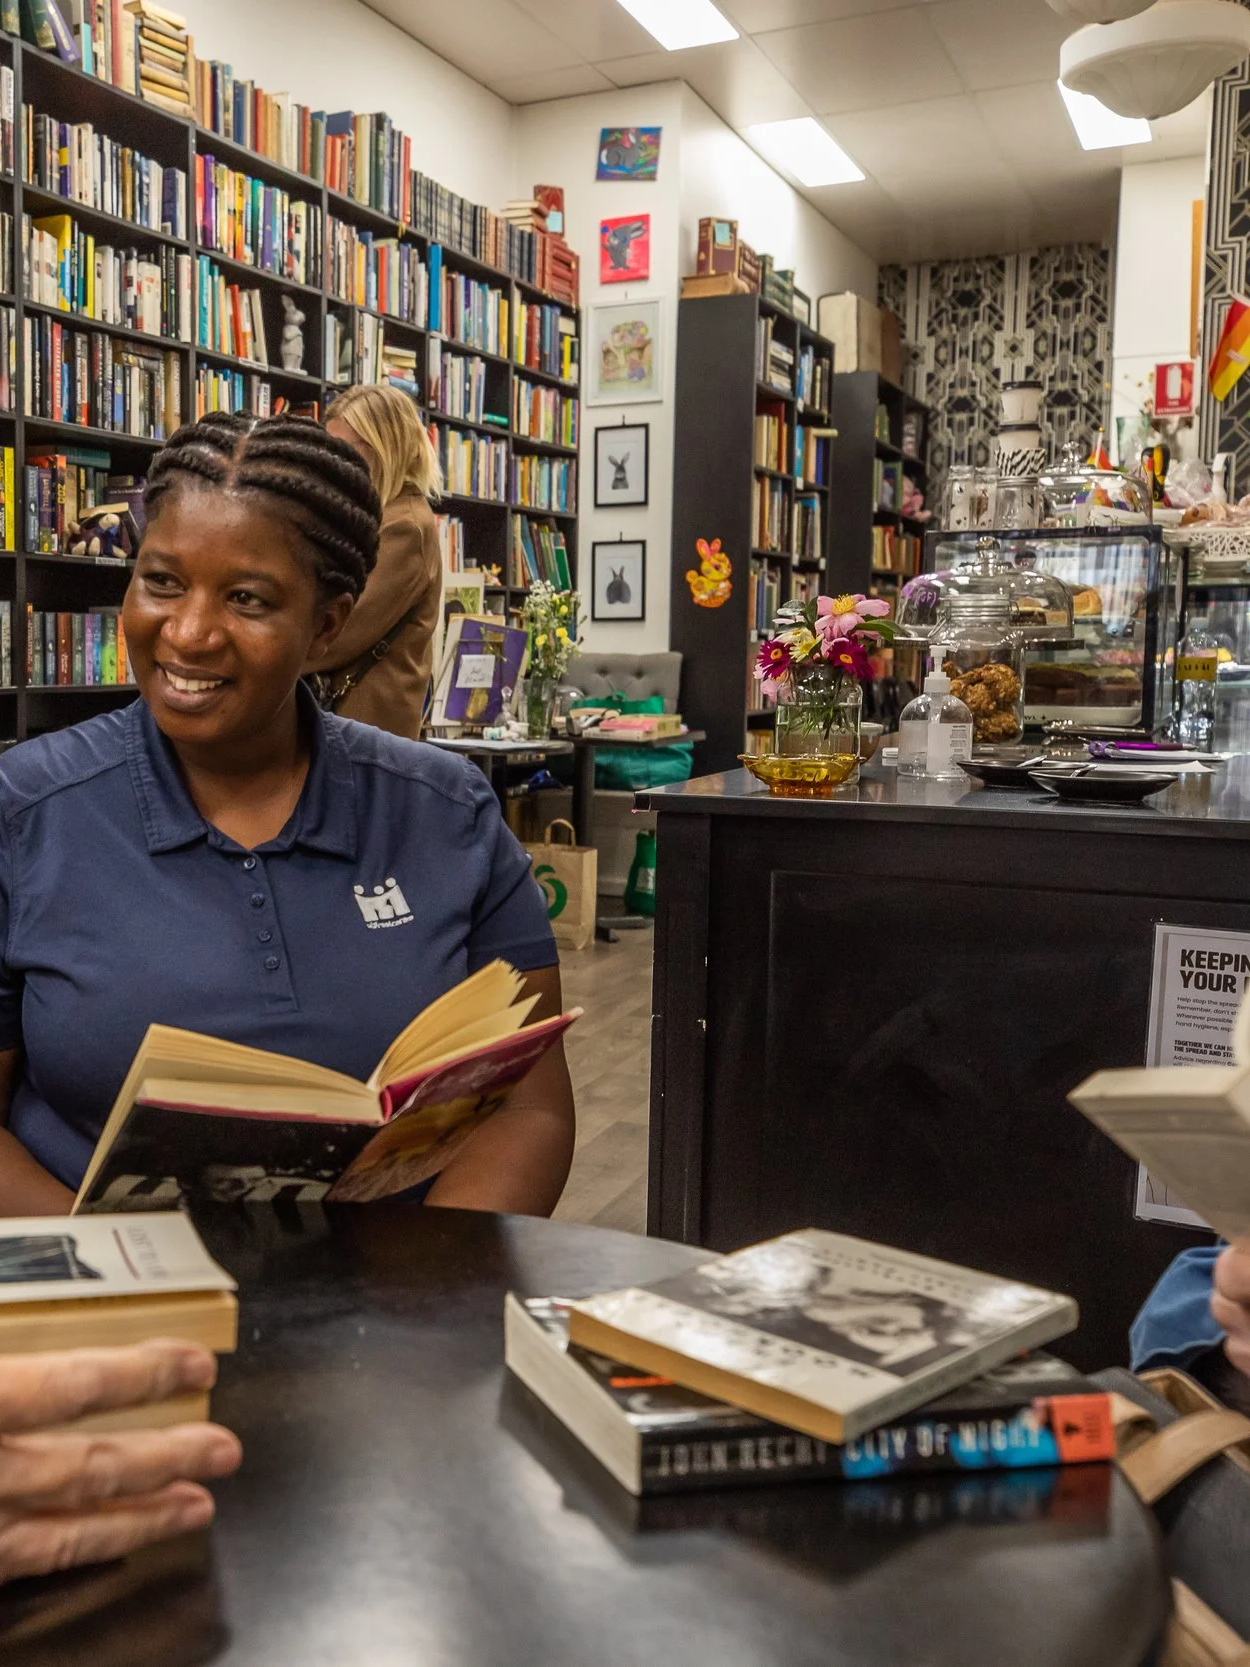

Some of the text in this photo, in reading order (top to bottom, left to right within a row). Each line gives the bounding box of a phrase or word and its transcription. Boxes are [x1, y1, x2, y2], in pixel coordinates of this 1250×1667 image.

[57, 483, 65, 504] ZOO
[1180, 970, 1237, 994] YOUR
[1177, 996, 1191, 1004] Help
[1192, 997, 1207, 1006] stop
[1176, 1004, 1211, 1014] Remember,
[1176, 1012, 1233, 1025] Wherever possible
[1175, 1020, 1220, 1032] hand hygiene,
[1174, 1039, 1203, 1049] TOGETHER
[1213, 1043, 1226, 1051] CAN
[1174, 1045, 1222, 1057] THE SPREAD AND
[1173, 1055, 1227, 1067] Advice regarding
[657, 1441, 729, 1477] JOHN
[845, 1427, 907, 1462] CITY
[916, 1424, 950, 1458] OF
